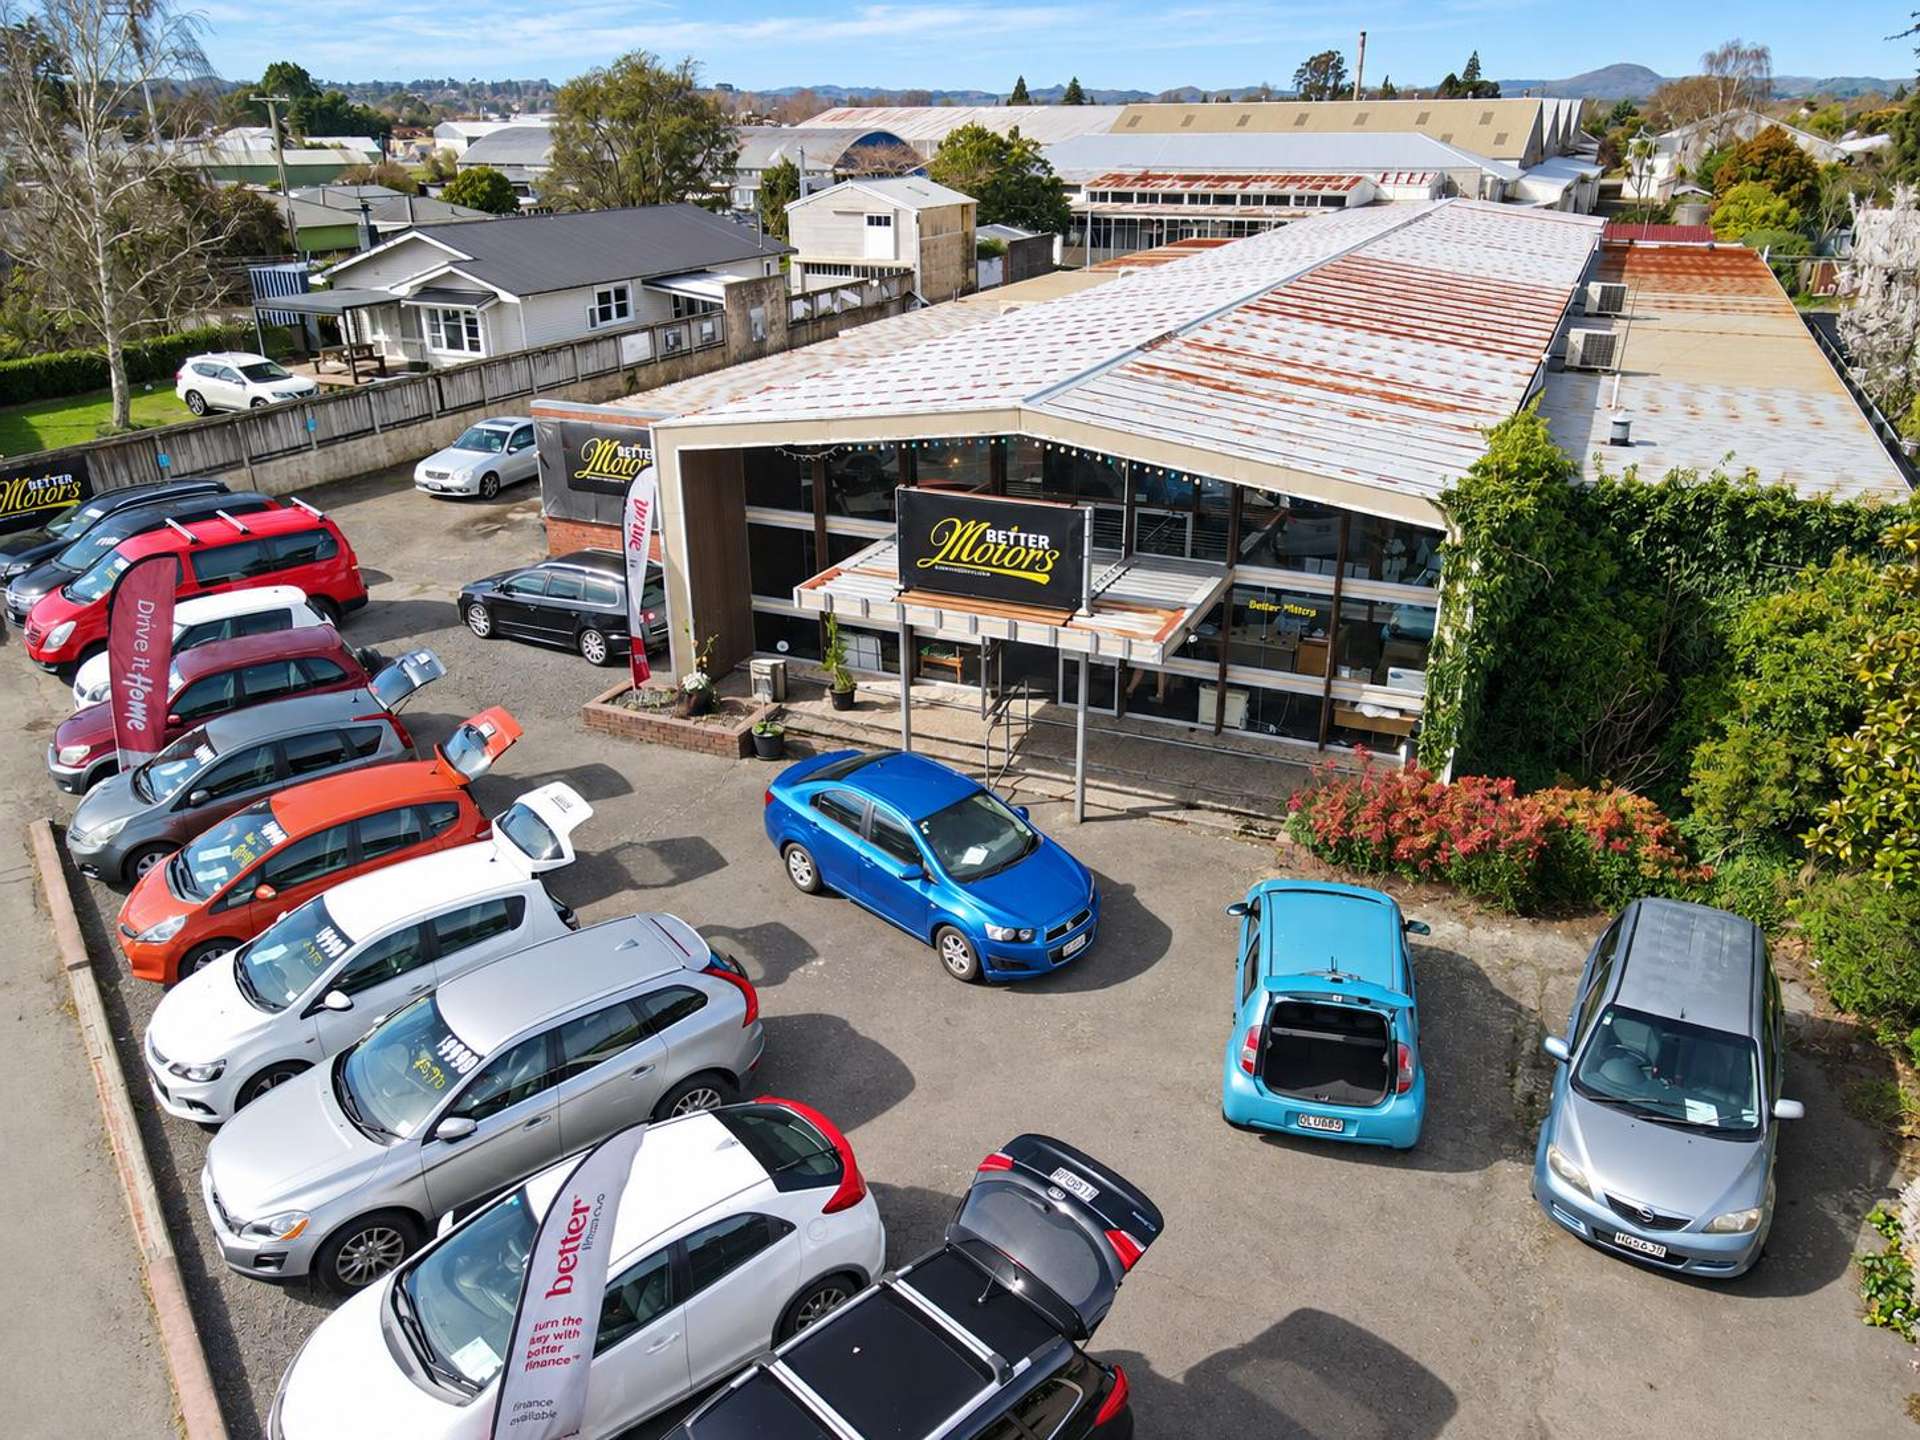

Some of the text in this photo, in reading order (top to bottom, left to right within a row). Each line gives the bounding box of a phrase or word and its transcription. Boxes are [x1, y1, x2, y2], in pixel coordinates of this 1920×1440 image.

[574, 438, 651, 479] Moto
[617, 446, 653, 460] BETTE
[28, 474, 73, 490] BETTER
[0, 478, 81, 513] Motors
[917, 517, 1060, 574] Motors
[986, 529, 1050, 551] BETTER
[121, 599, 155, 731] Drive it Home
[545, 1194, 591, 1300] better
[562, 1316, 582, 1327] the
[553, 1330, 580, 1341] with
[513, 1399, 553, 1412] finance
